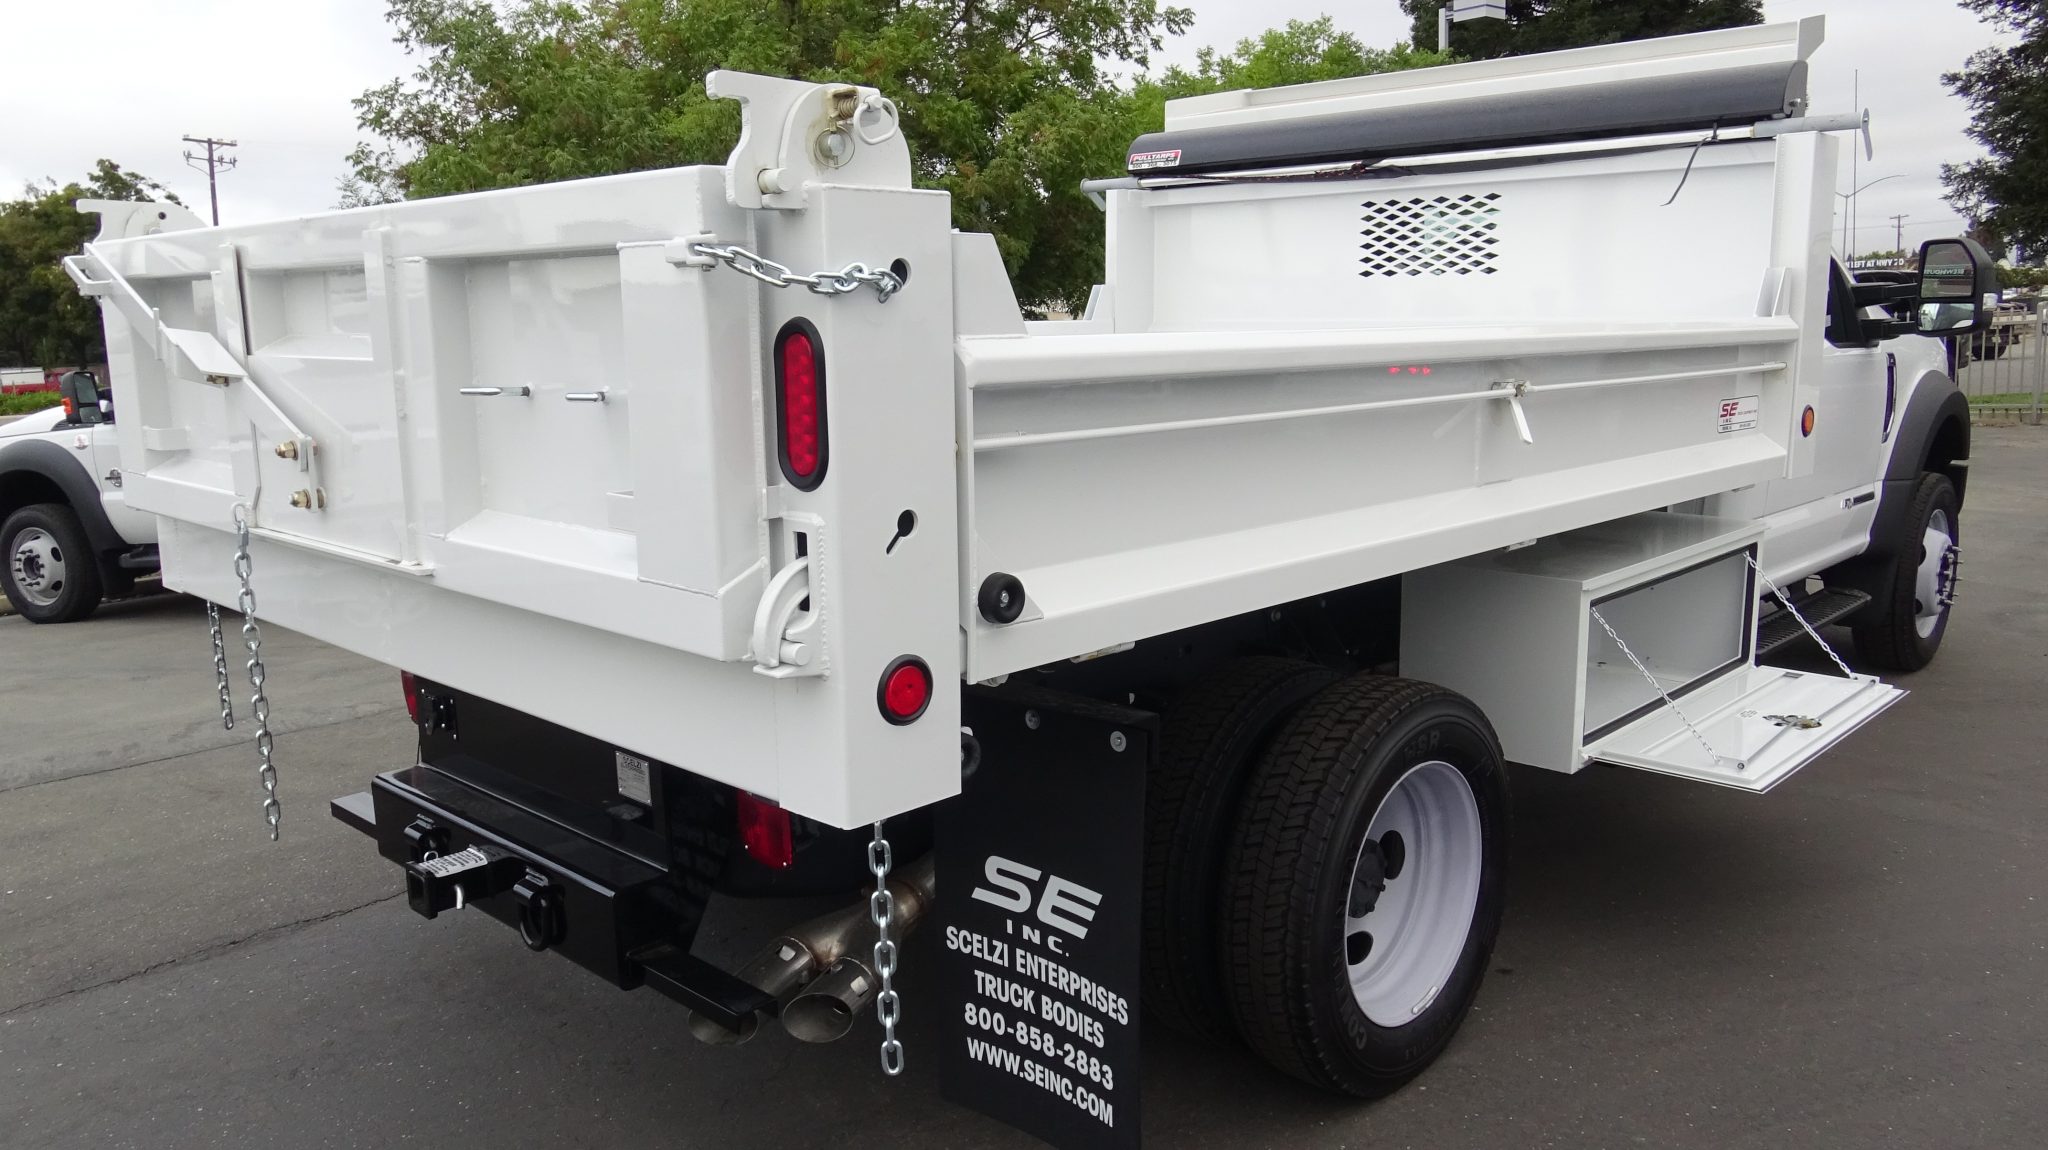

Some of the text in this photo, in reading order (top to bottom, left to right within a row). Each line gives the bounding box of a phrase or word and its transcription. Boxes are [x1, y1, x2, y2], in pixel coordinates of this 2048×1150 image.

[1133, 152, 1176, 161] PULLTARPS
[1851, 260, 1866, 268] LEFT
[1720, 402, 1739, 418] SE
[971, 855, 1103, 939] SE
[946, 925, 1129, 1025] SCELZI ENTERPRISES
[974, 970, 1105, 1048] TRUCK BODIES
[964, 1002, 1114, 1091] 800-858-2883
[967, 1037, 1114, 1128] WWW.SEINC.COM
